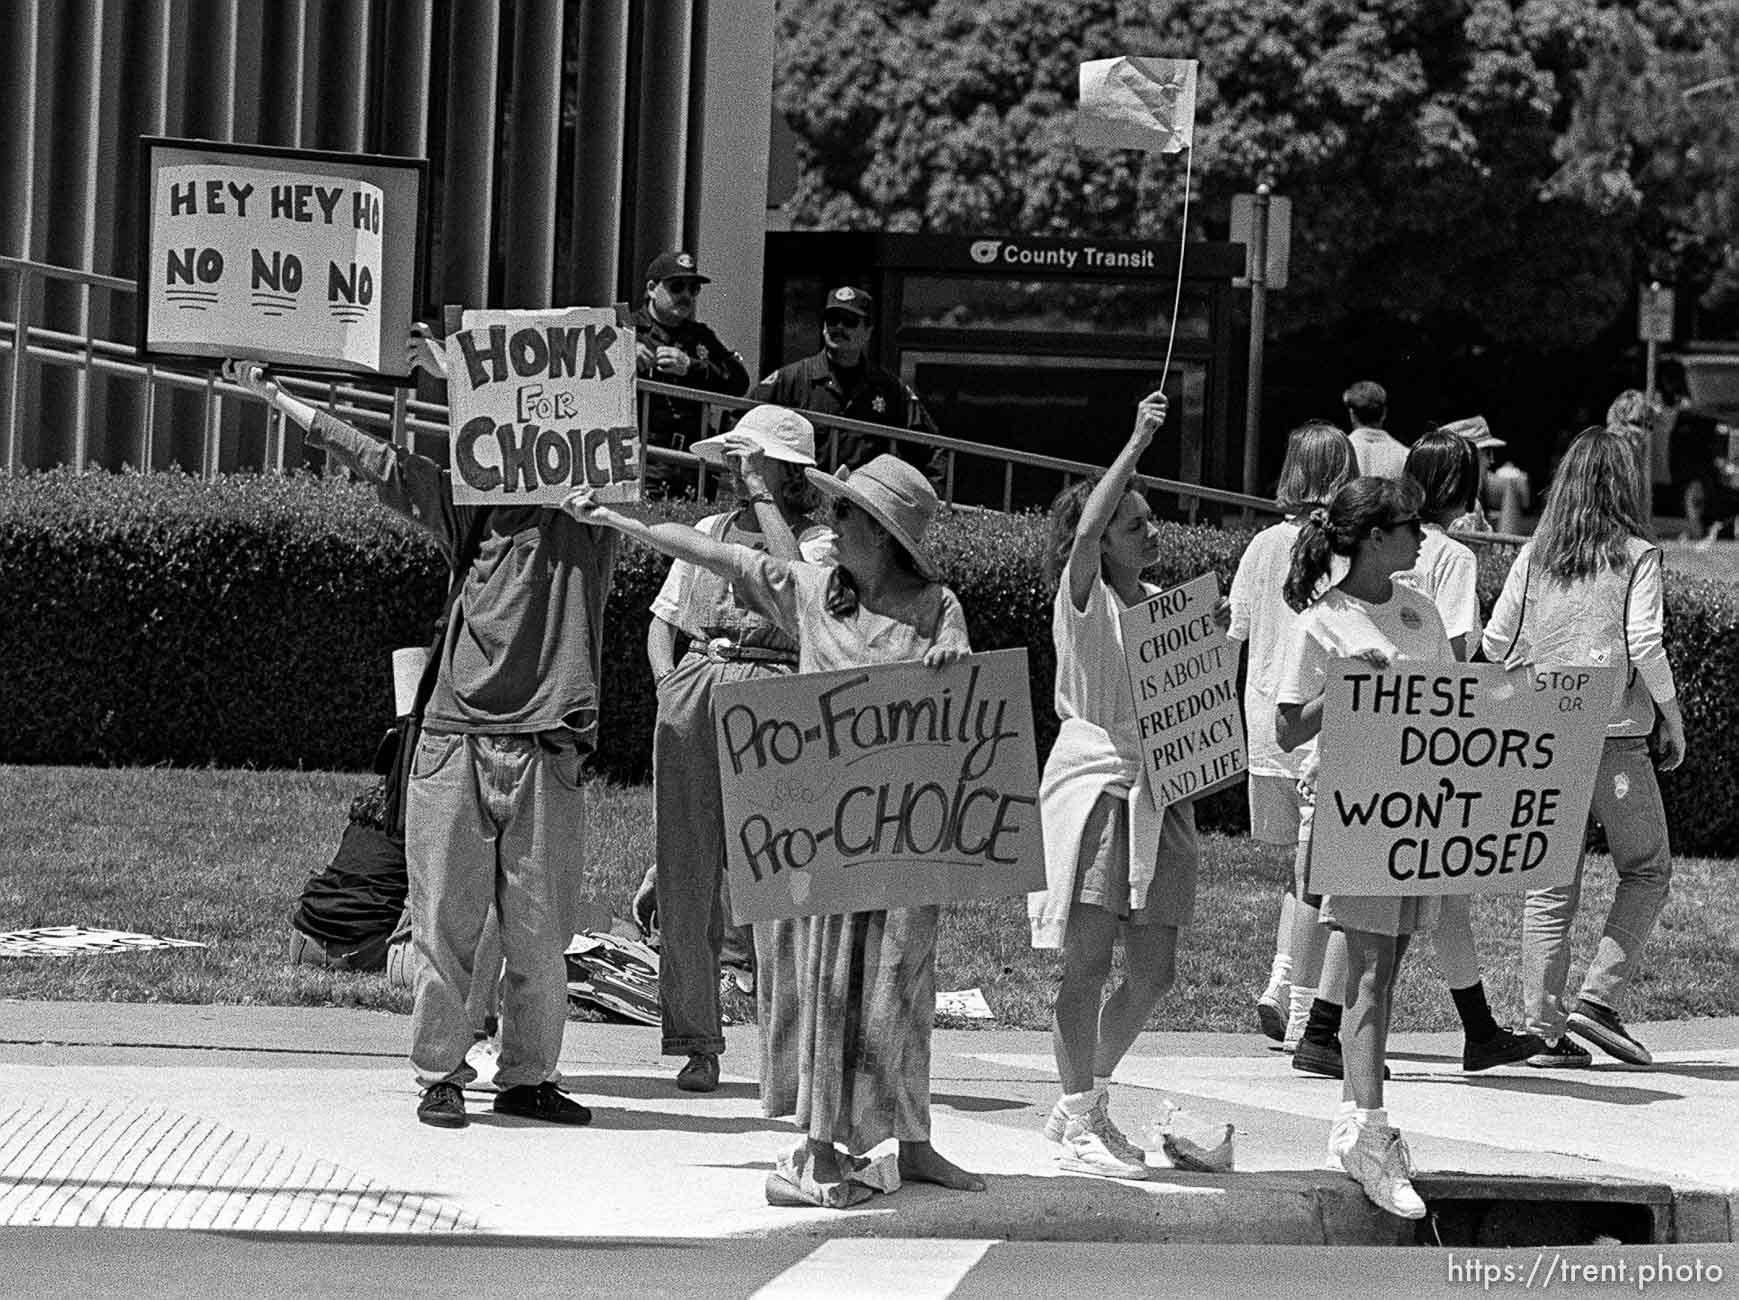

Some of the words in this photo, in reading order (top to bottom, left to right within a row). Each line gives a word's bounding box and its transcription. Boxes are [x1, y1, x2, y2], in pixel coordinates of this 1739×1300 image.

[171, 180, 254, 217] HEY
[271, 184, 343, 224] HEY
[353, 191, 380, 234] HO
[167, 248, 224, 285] NO
[251, 248, 302, 293] NO
[328, 260, 373, 305] NO
[1004, 245, 1078, 268] County
[1083, 247, 1154, 267] Transit
[456, 324, 618, 391] HONK
[455, 416, 640, 493] CHOICE
[1149, 588, 1193, 624] PRO-
[1139, 614, 1214, 664] CHOICE
[1140, 675, 1158, 701] IS
[1163, 646, 1224, 692] ABOUT
[1344, 674, 1479, 718] THESE
[1535, 671, 1590, 693] STOP
[721, 665, 1018, 781] Pro-Family
[1152, 714, 1235, 772] PRIVACY
[1400, 726, 1555, 770] DOORS
[1161, 770, 1197, 807] AND
[1201, 749, 1244, 786] LIFE
[1334, 777, 1482, 828] WON'T
[1510, 789, 1561, 828] BE
[740, 777, 1036, 882] Pro-CHOICE
[1388, 830, 1548, 880] CLOSED
